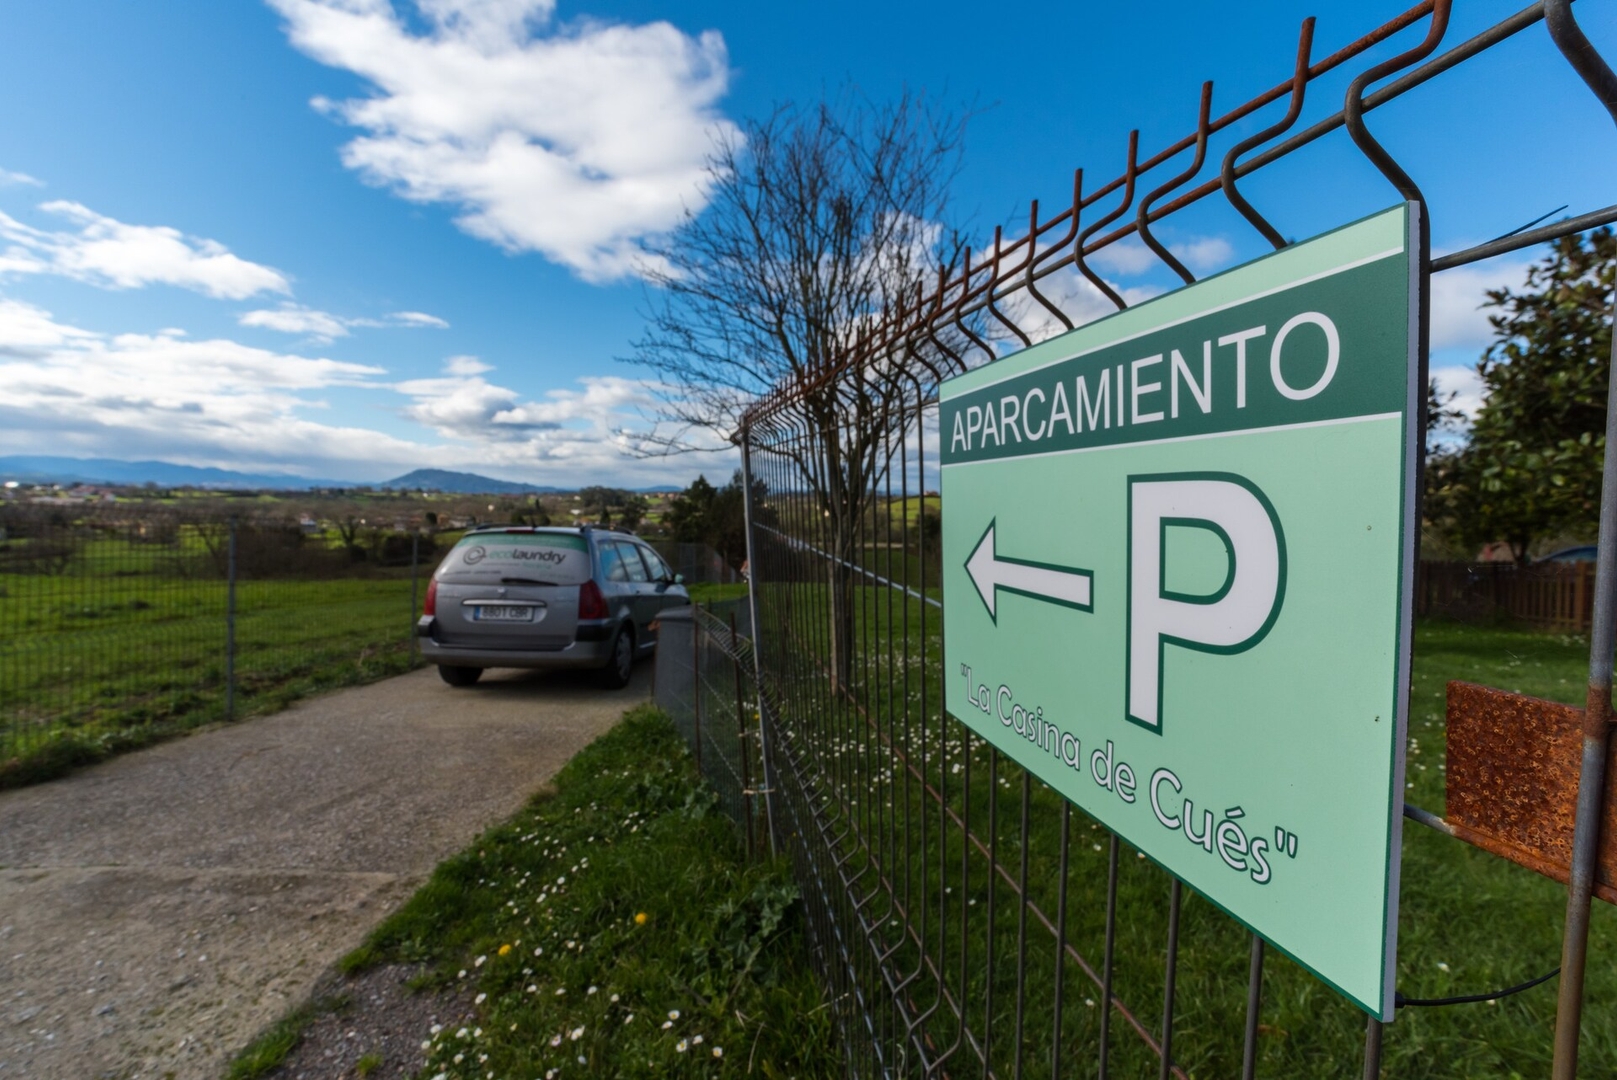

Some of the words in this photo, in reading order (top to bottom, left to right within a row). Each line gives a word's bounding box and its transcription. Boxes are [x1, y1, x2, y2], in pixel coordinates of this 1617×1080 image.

[951, 311, 1340, 453] APARCAMIENTO
[489, 548, 566, 565] ecolaundry
[1125, 471, 1288, 736] P
[960, 663, 991, 714] "La
[996, 685, 1080, 771] Casina
[1091, 740, 1137, 803] de
[1150, 767, 1298, 885] Cués"
